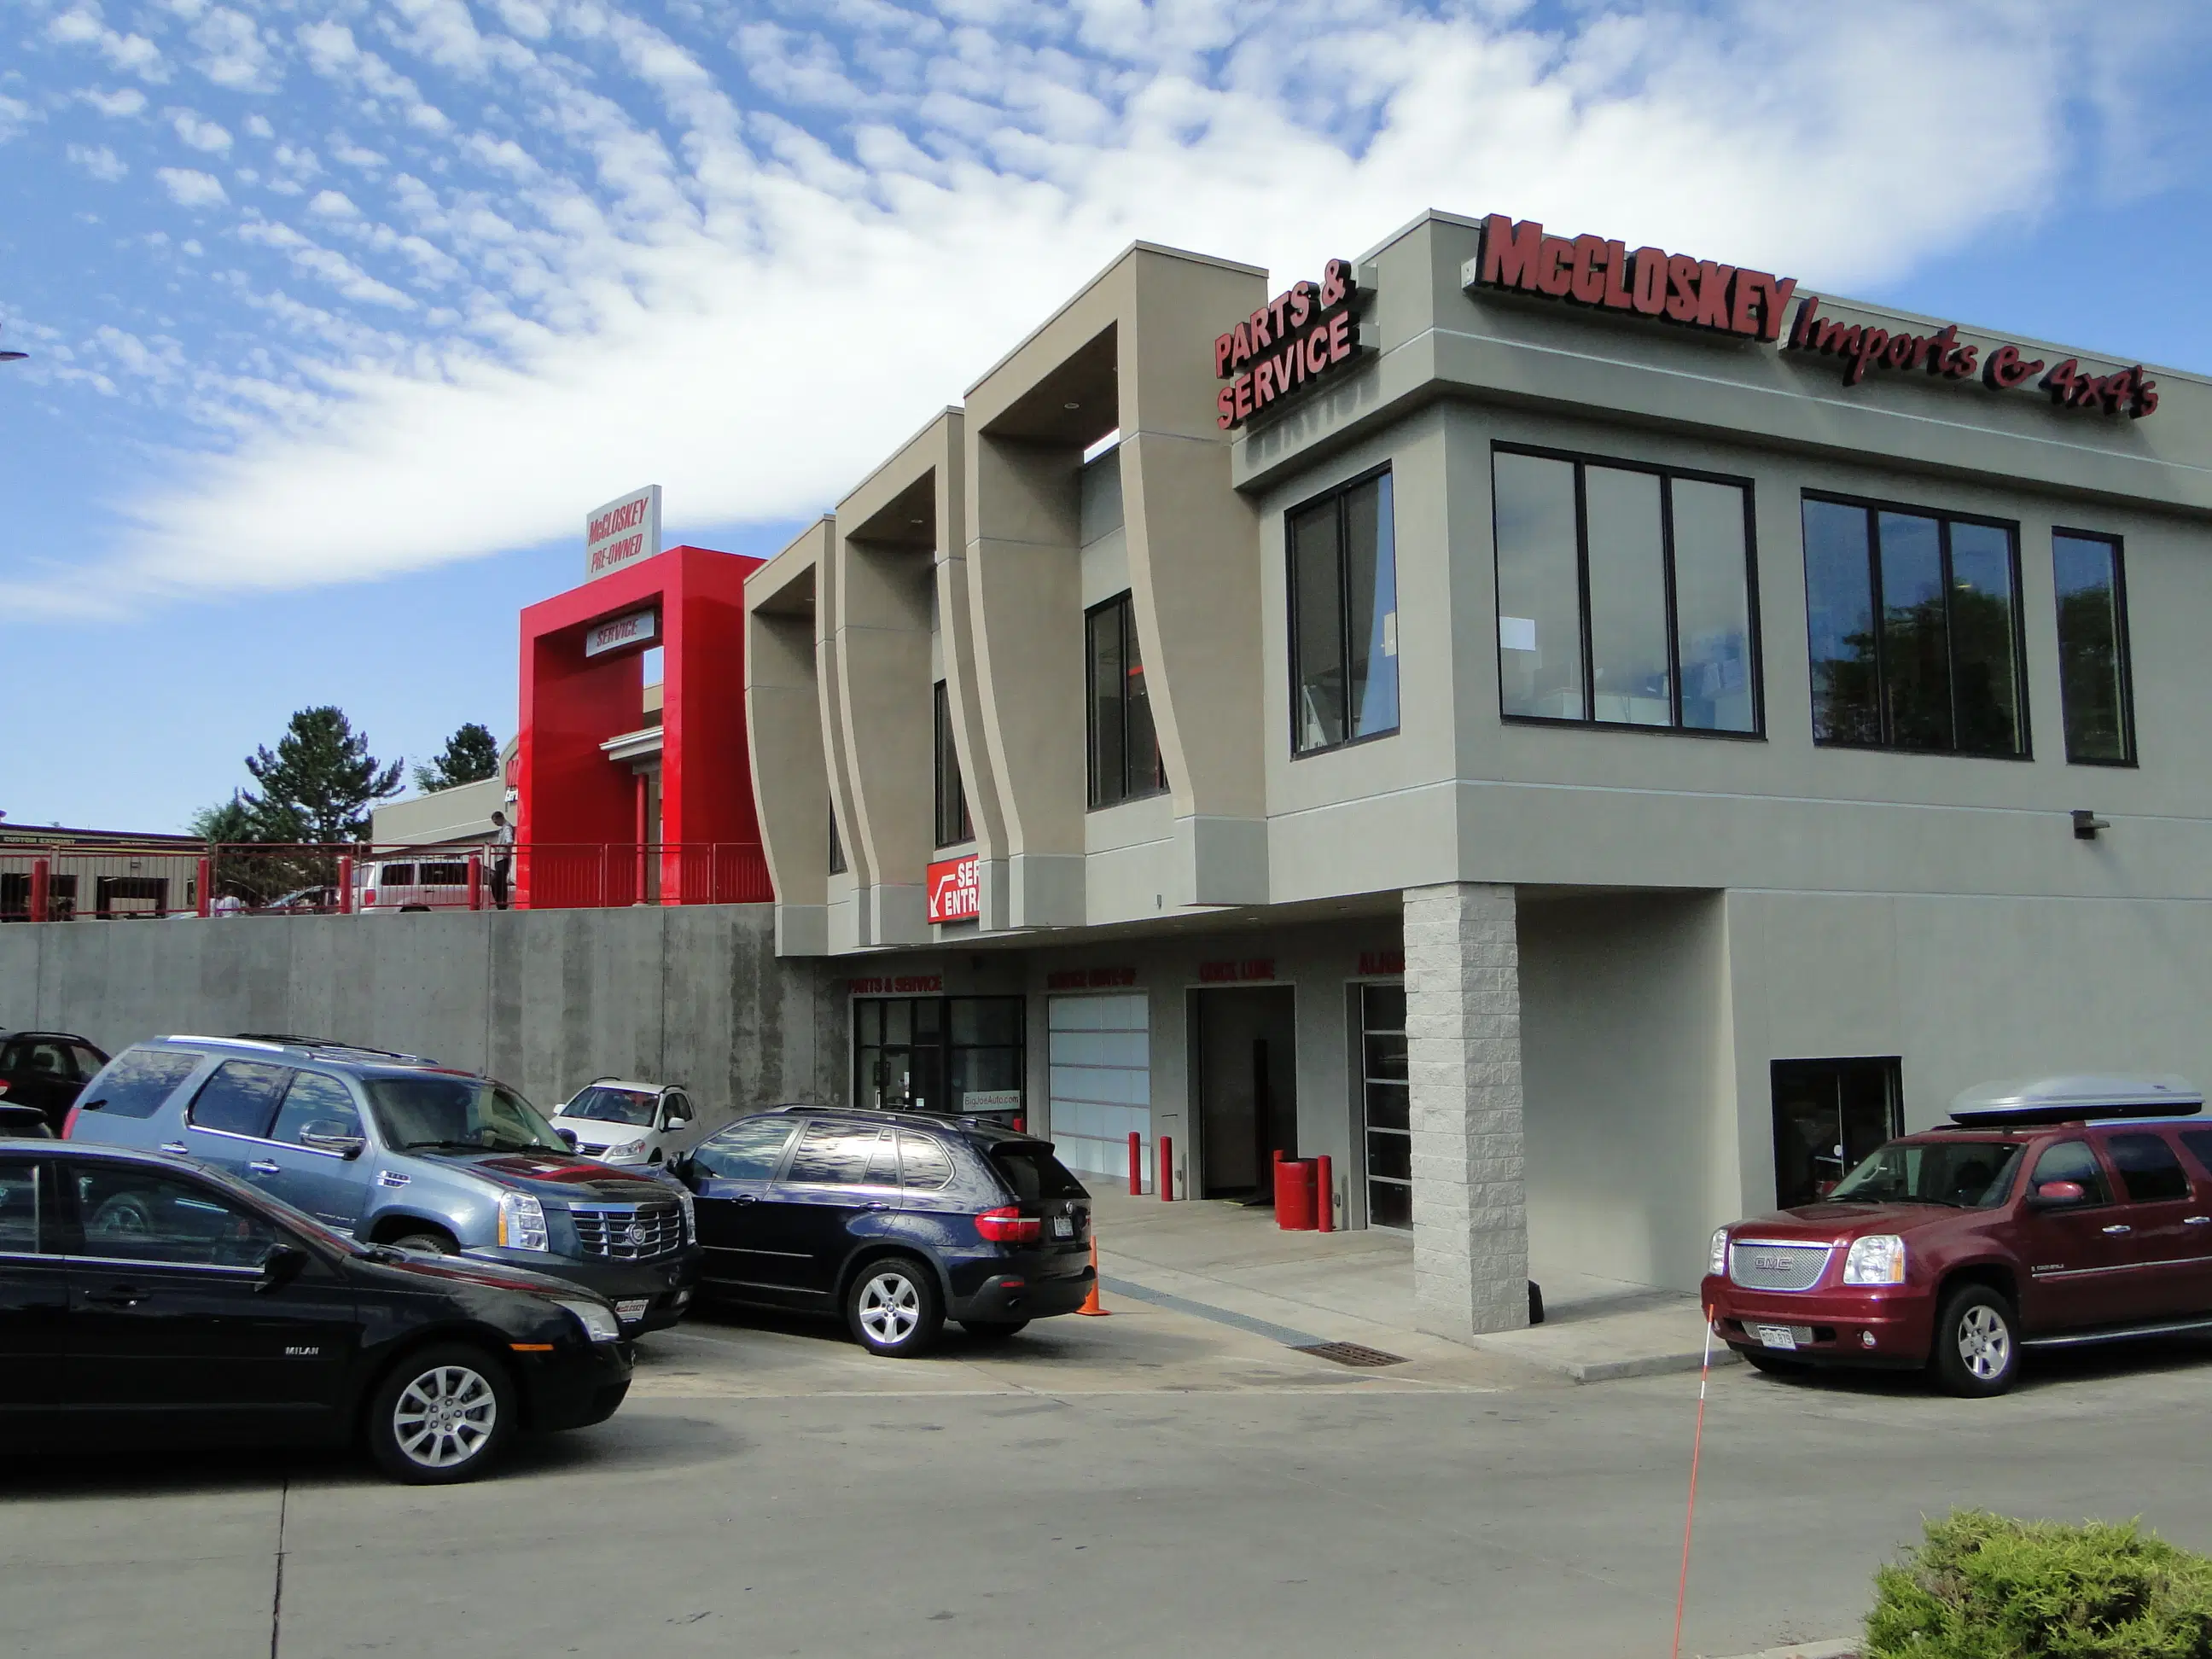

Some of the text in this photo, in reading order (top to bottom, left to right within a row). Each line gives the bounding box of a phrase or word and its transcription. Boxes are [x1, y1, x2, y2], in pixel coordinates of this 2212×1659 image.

[1215, 259, 1355, 380] PARTS &
[1792, 296, 1978, 386] Imports
[1216, 310, 1359, 430] SERVICE
[591, 533, 643, 573] PRE-OWNED
[597, 619, 638, 646] SERVICE
[945, 887, 980, 916] ENTR
[1755, 1255, 1791, 1270] GMC
[285, 1347, 319, 1355] MILAN
